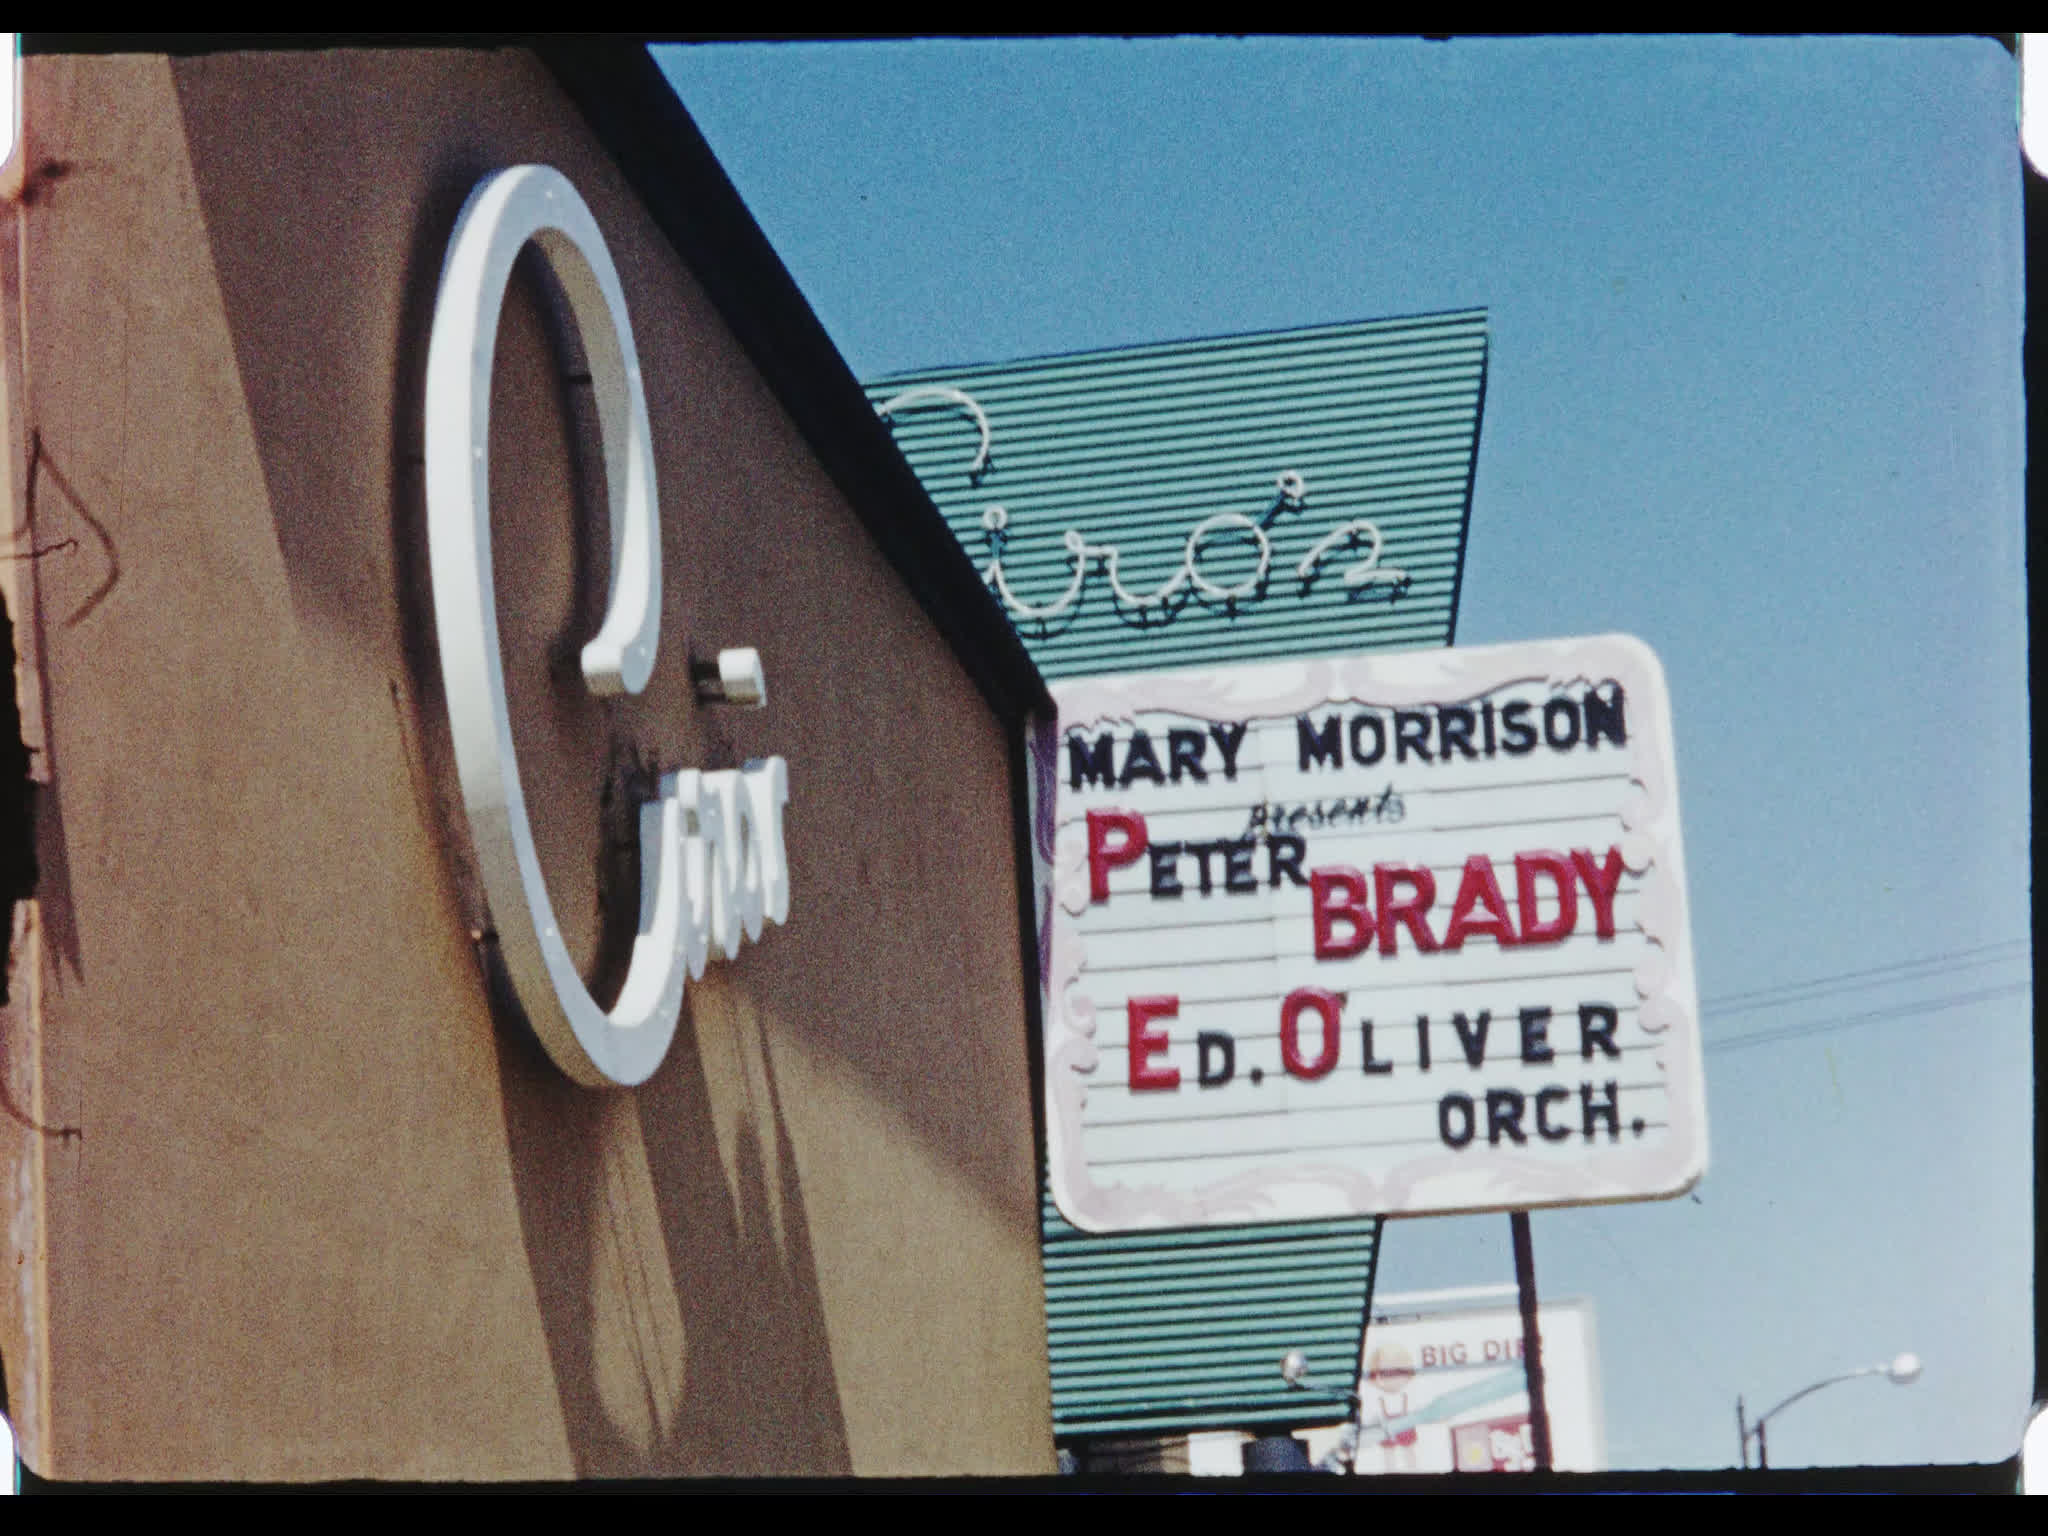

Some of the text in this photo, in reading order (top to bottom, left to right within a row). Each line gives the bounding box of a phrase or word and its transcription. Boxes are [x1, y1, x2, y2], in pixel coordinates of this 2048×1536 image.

[1068, 678, 1626, 790] MARY MORRISON
[1087, 808, 1626, 960] PETER BRADY
[1438, 1080, 1648, 1150] ORCH.
[1421, 1342, 1467, 1369] BIG
